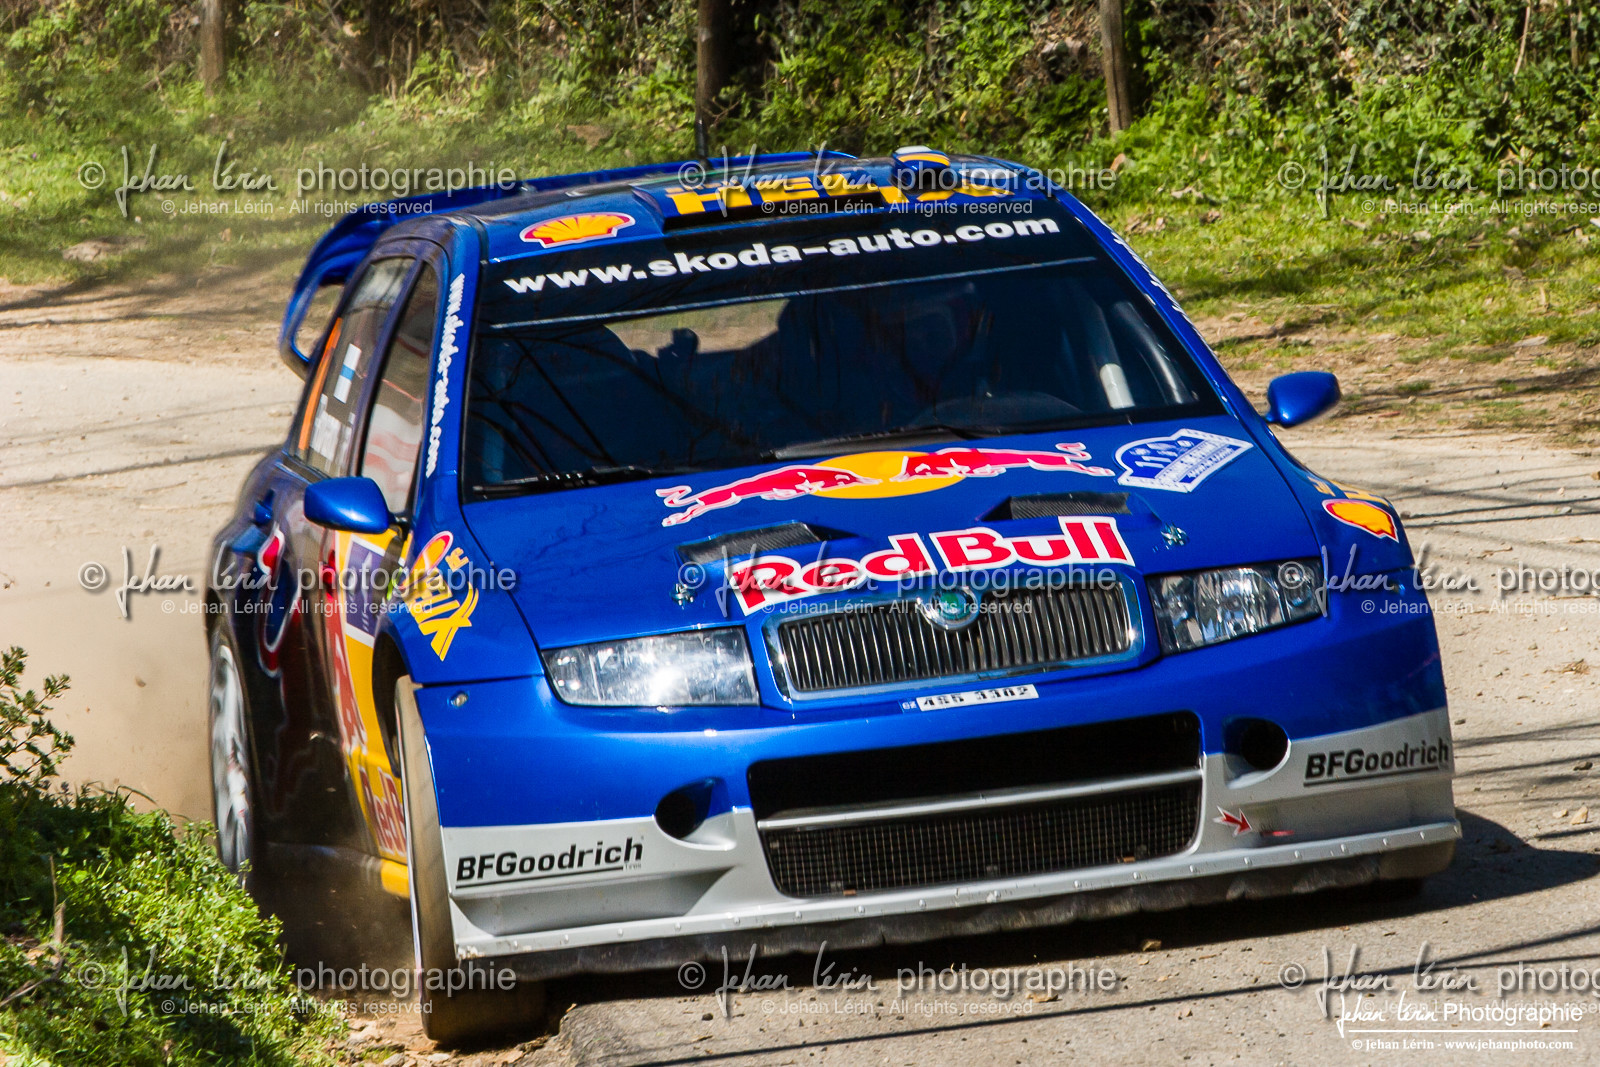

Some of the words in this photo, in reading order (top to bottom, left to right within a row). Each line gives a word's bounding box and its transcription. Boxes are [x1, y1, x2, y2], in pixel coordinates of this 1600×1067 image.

[503, 217, 1061, 294] www.skoda-auto.com
[723, 532, 939, 617] Red
[928, 516, 1136, 573] Bull
[1305, 737, 1449, 779] BFGoodrich
[456, 837, 644, 881] BFGoodrich
